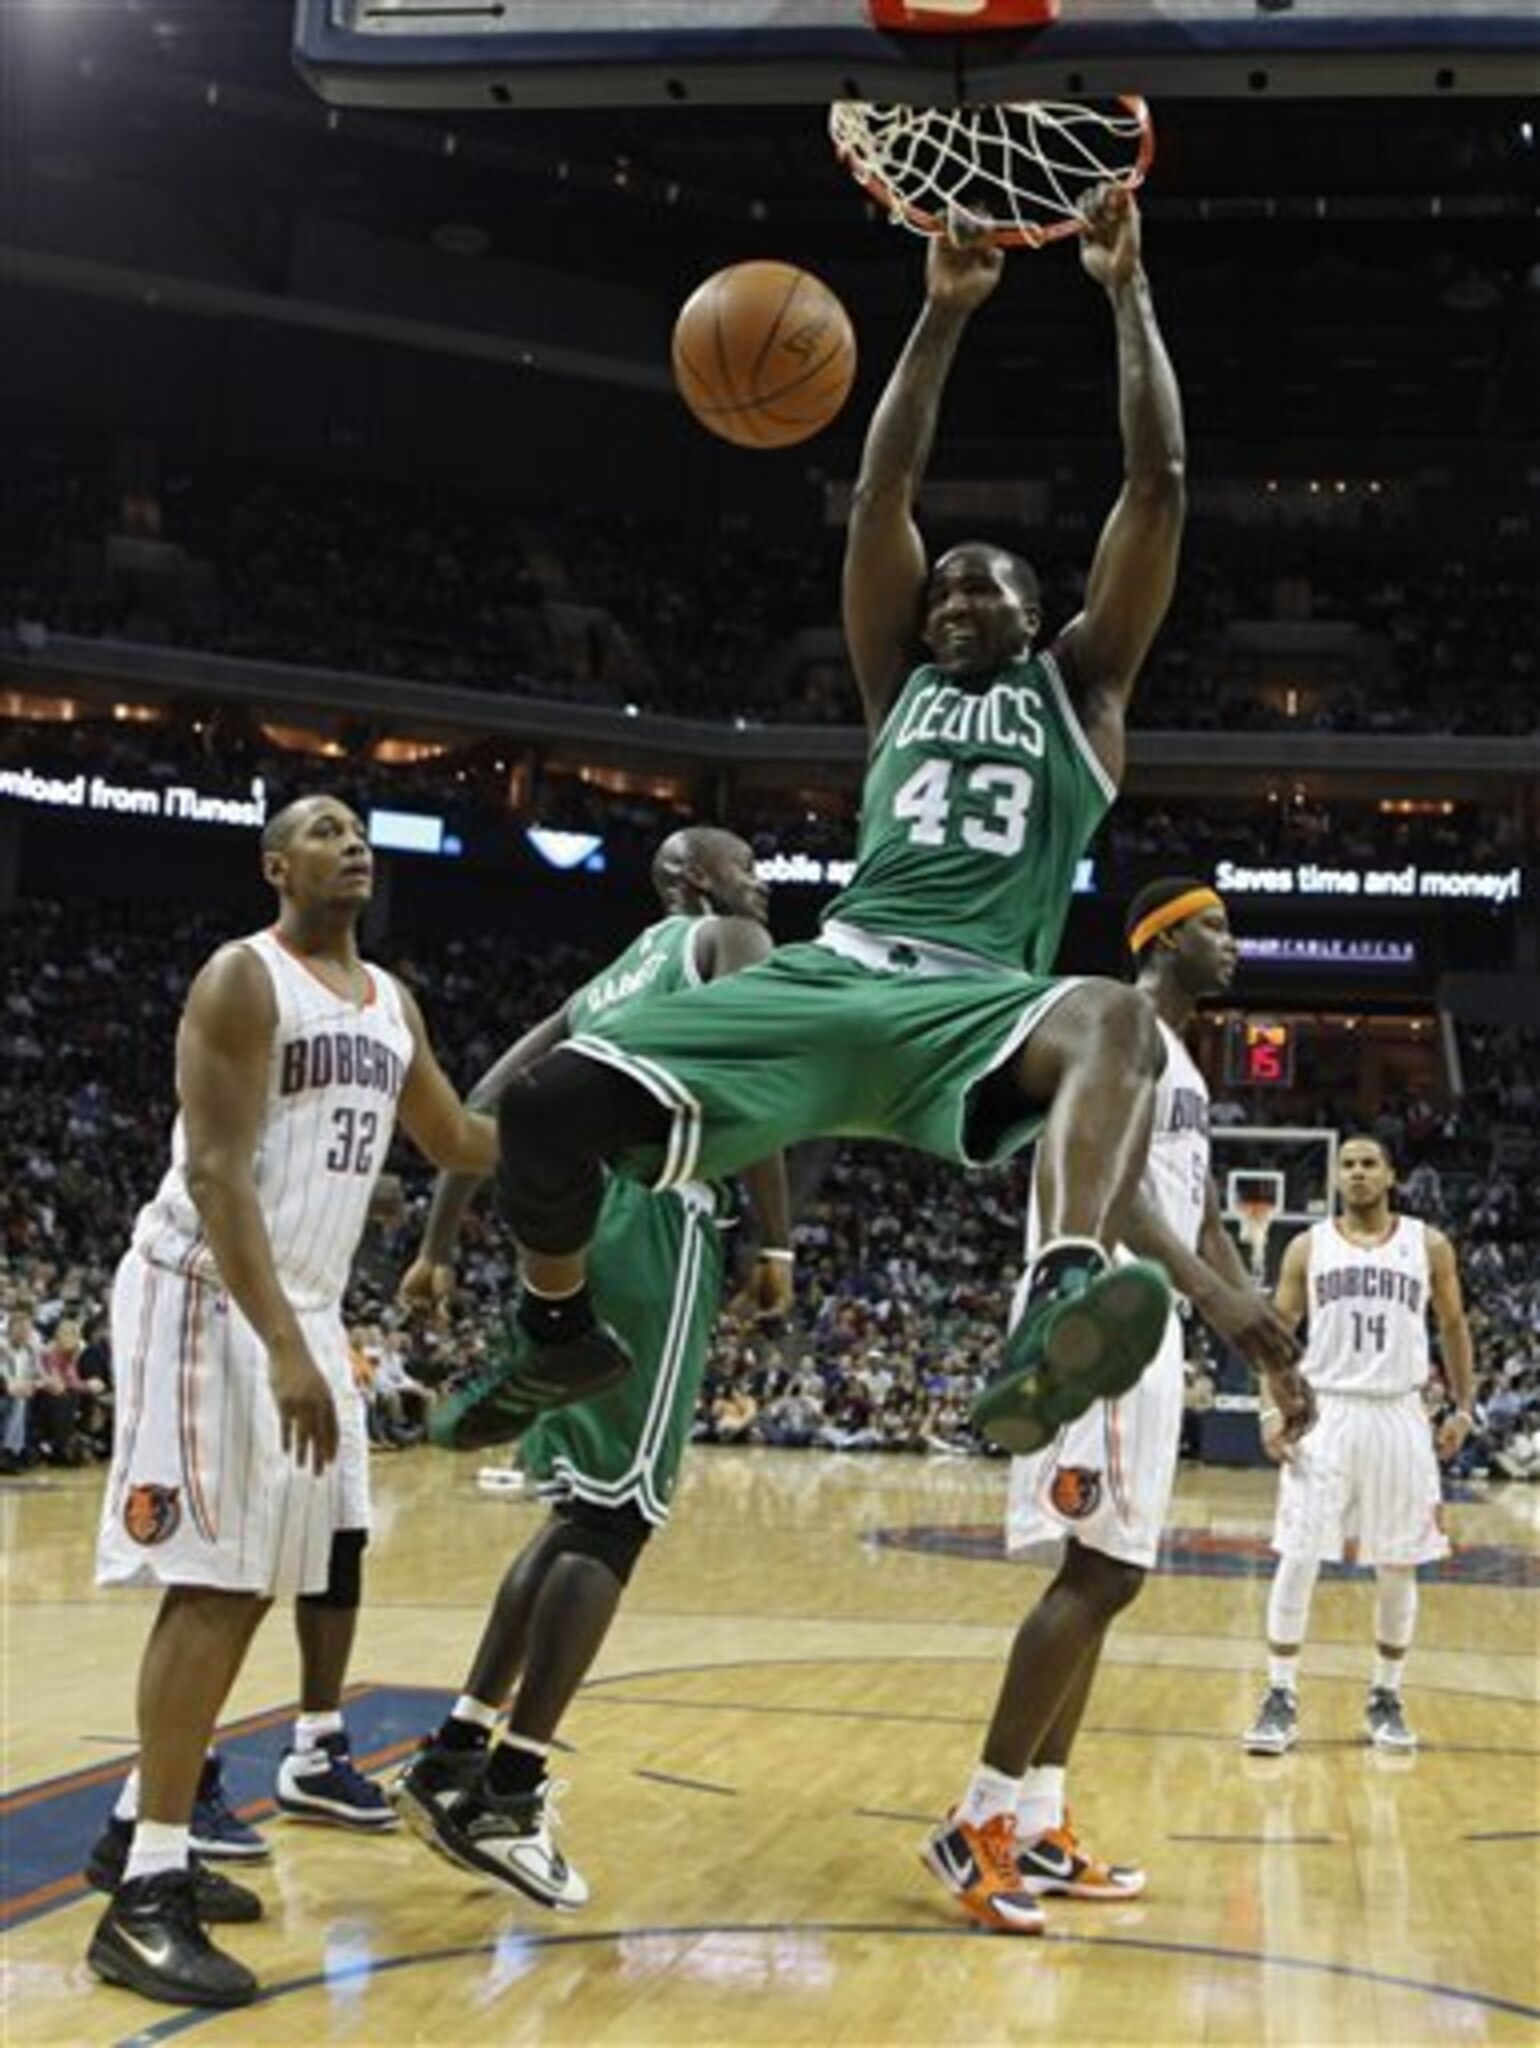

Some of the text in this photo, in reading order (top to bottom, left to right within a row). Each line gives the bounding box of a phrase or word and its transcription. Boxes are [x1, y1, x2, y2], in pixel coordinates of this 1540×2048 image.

[896, 683, 1045, 757] CELTICS
[90, 776, 159, 815] from
[894, 759, 1033, 857] 43
[754, 852, 821, 882] obile
[1216, 861, 1521, 903] Saves time and money!
[327, 1107, 377, 1174] 32
[1351, 1310, 1385, 1352] 14
